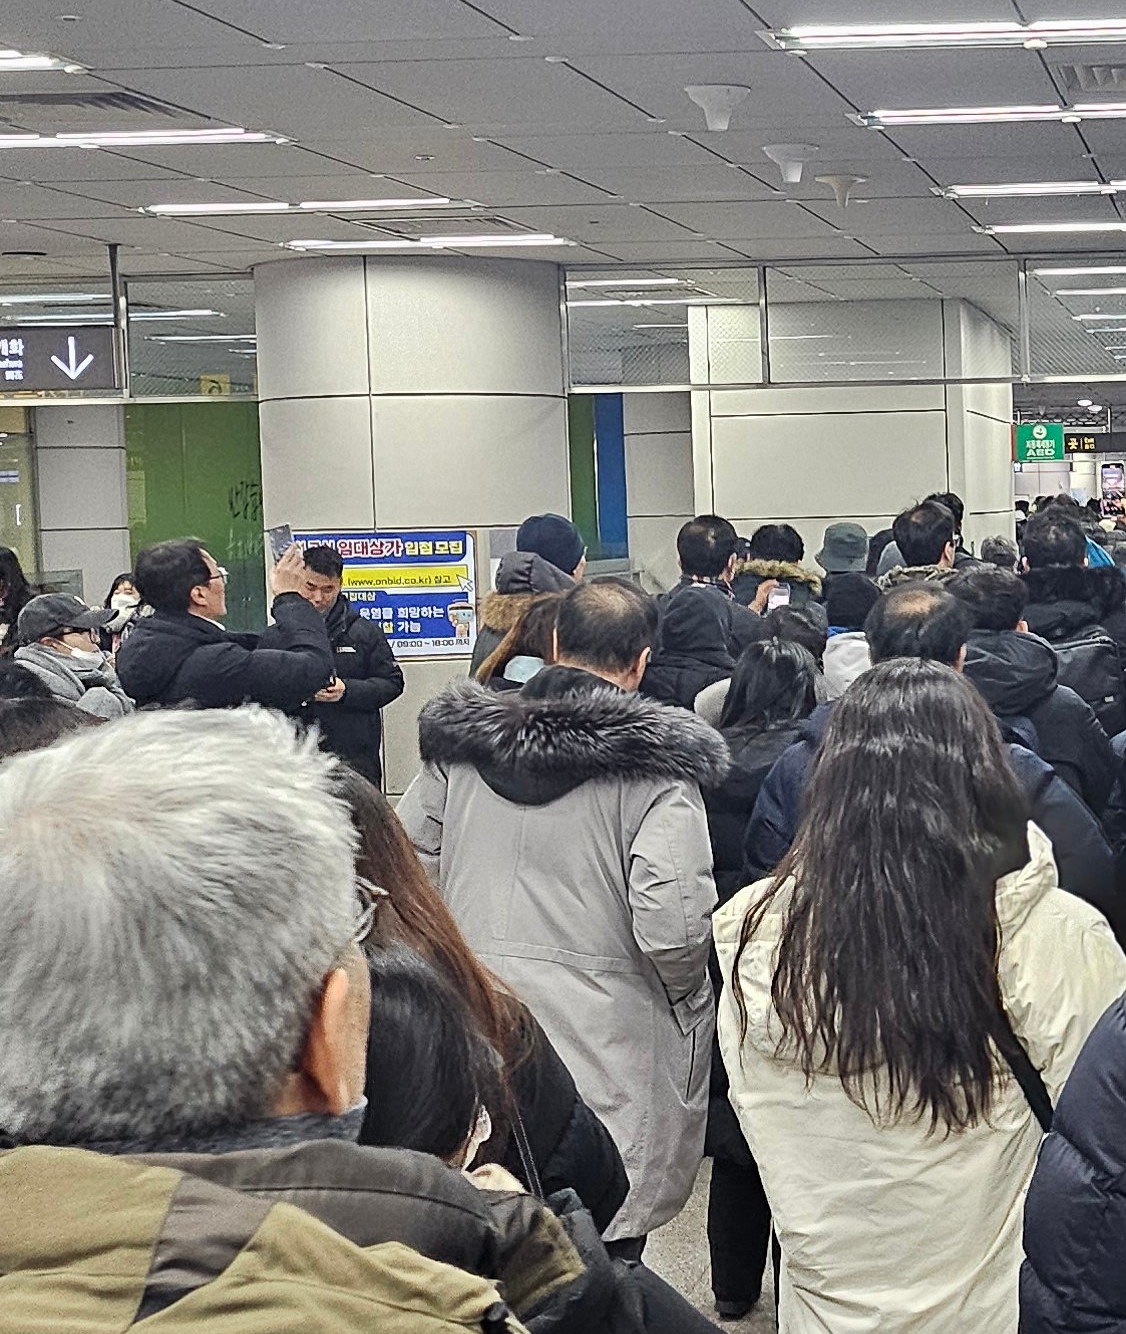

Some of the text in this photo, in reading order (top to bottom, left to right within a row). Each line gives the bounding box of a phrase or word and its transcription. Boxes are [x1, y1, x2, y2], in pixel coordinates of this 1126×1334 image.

[1026, 448, 1056, 457] AED
[336, 538, 404, 559] 임대상가
[404, 540, 433, 556] 입점
[434, 540, 464, 555] 모집
[347, 575, 432, 587] (www.onbid.co.kr)
[397, 605, 445, 619] 희망하는
[396, 640, 423, 648] 09:00
